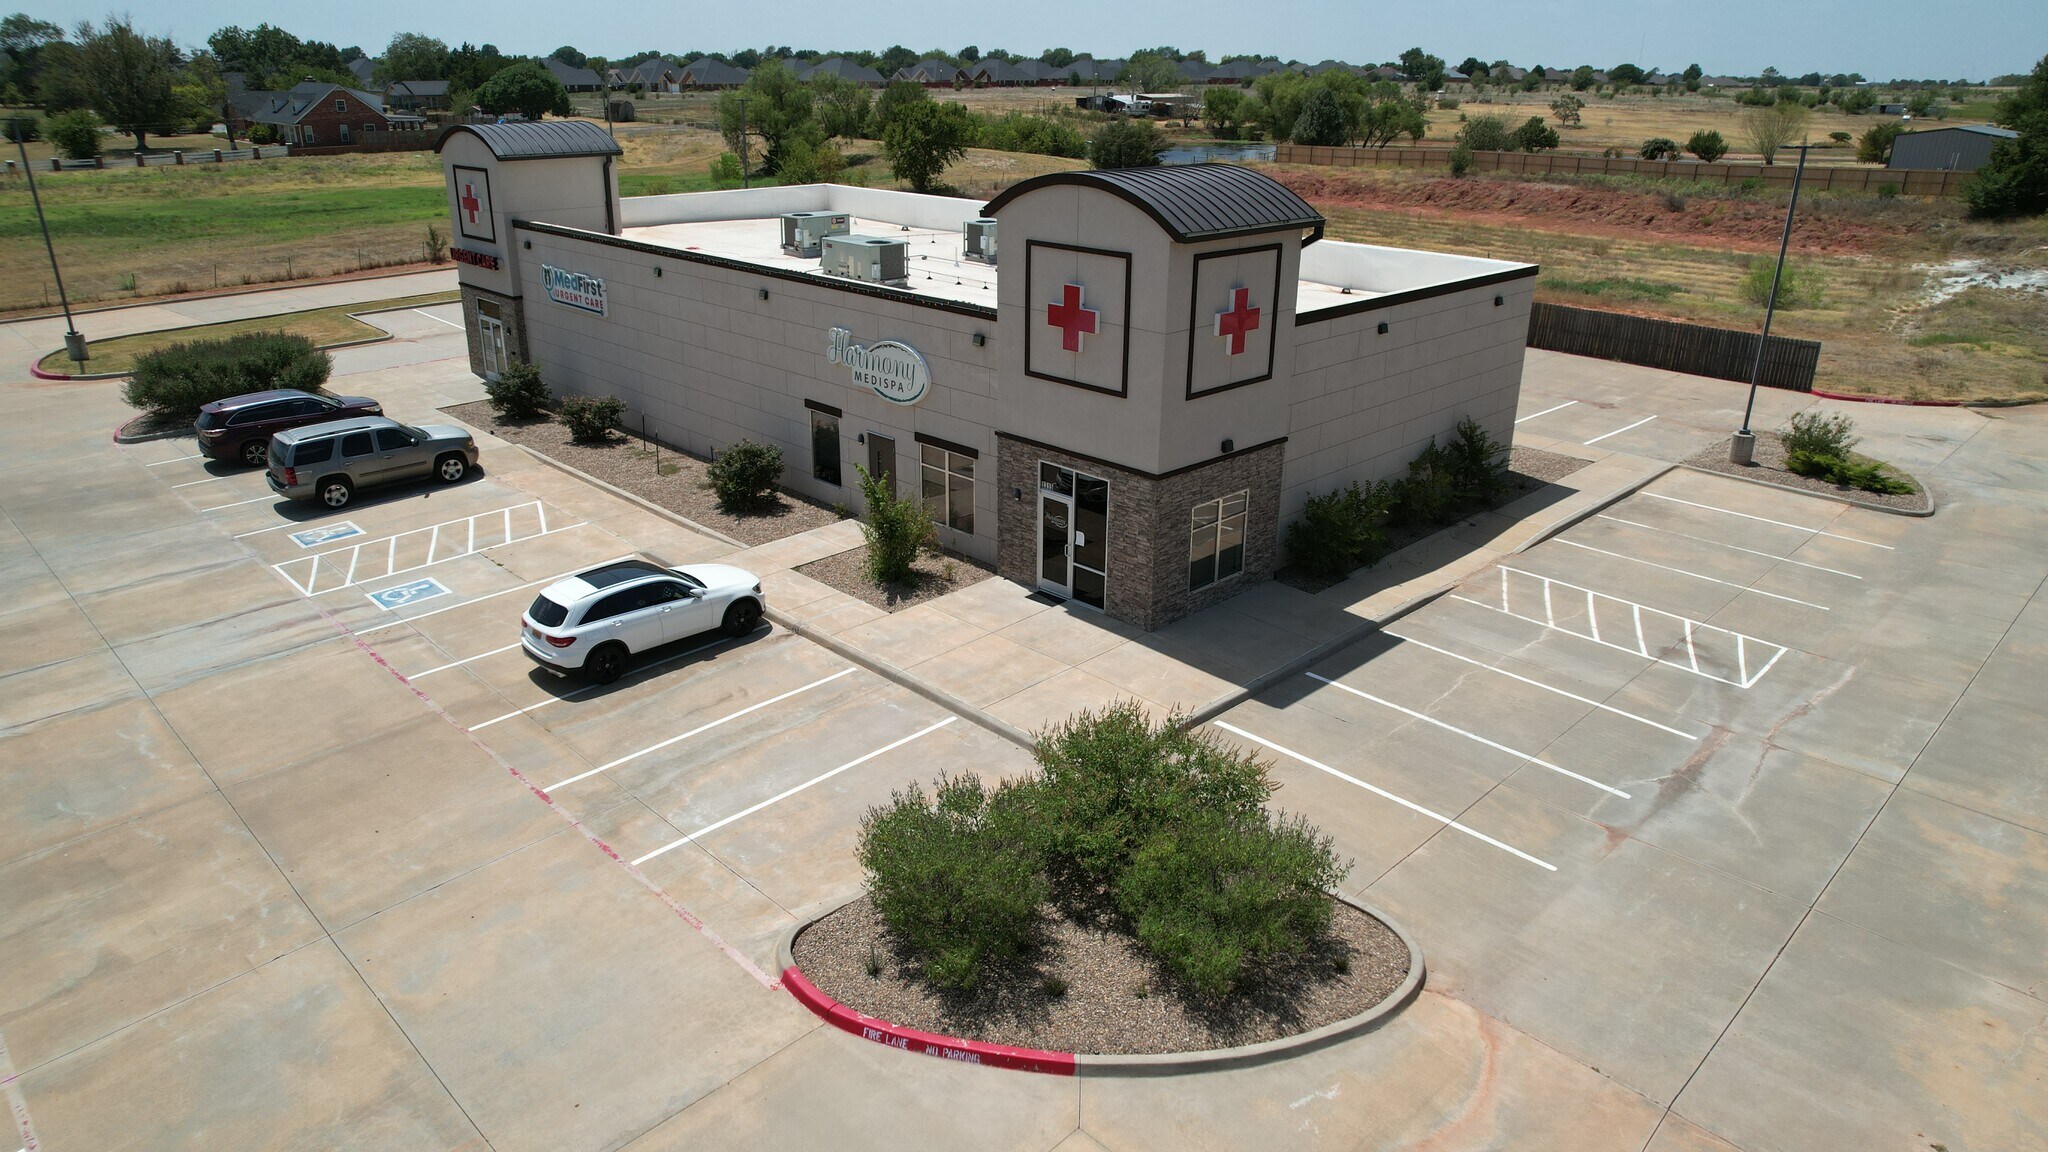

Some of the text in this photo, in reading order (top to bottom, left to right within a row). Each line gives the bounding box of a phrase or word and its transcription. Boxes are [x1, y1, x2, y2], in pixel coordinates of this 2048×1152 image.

[554, 270, 602, 297] MedFirst
[555, 289, 604, 310] URGENT CARE
[828, 328, 915, 391] Harmony
[854, 371, 904, 392] MEDISPA
[862, 1026, 980, 1064] FIRE LANE NO PARKING
